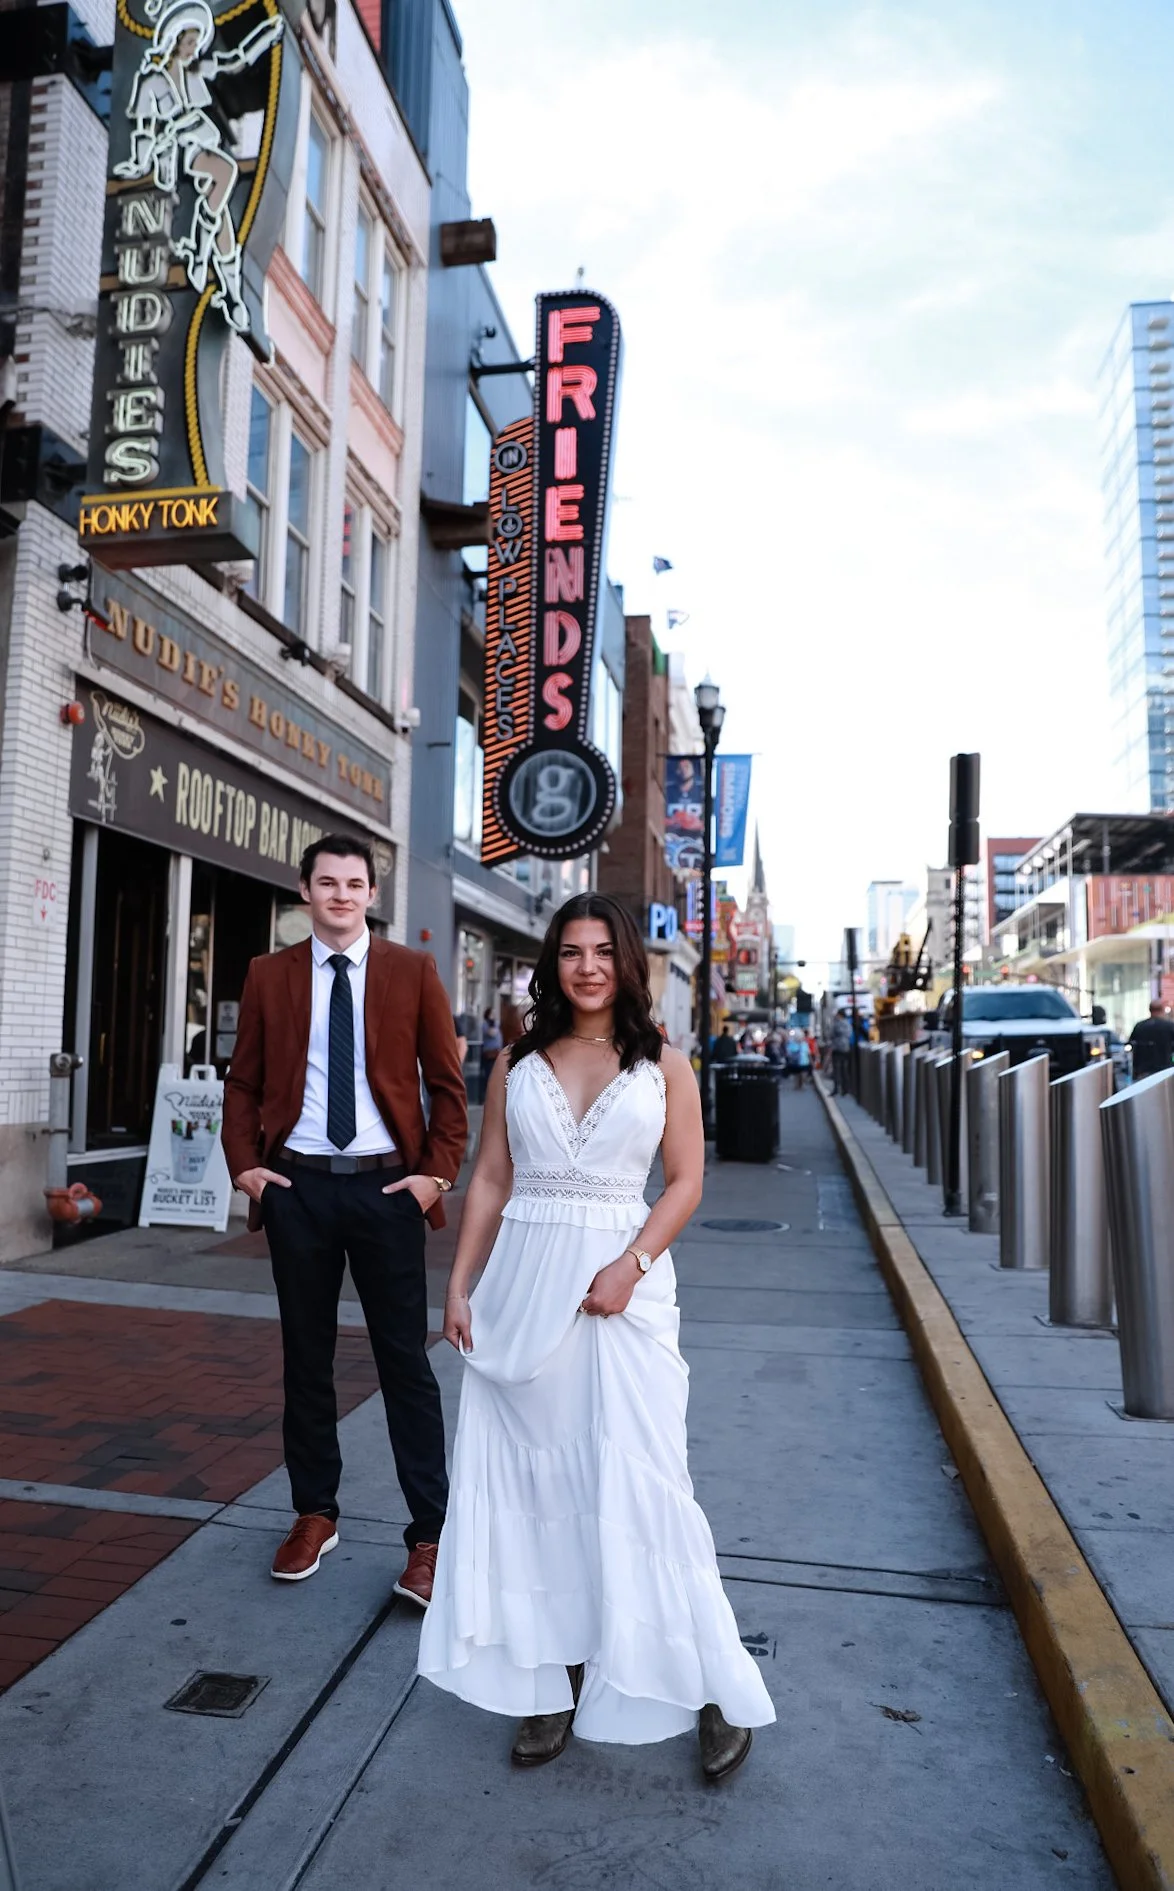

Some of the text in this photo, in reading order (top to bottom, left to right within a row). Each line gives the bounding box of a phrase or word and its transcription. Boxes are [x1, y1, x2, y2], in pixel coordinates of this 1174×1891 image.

[103, 191, 178, 488] NUDIES
[79, 496, 219, 537] HONKY TONK
[543, 306, 600, 731] FRIENDS
[493, 447, 522, 741] IN LOW PLACES
[106, 598, 384, 803] NUDIE'S HONKY TONK
[175, 762, 256, 849] ROOFTOP
[259, 802, 289, 864] BAR
[34, 879, 57, 901] FDC
[152, 1193, 217, 1207] BUCKET LIST
